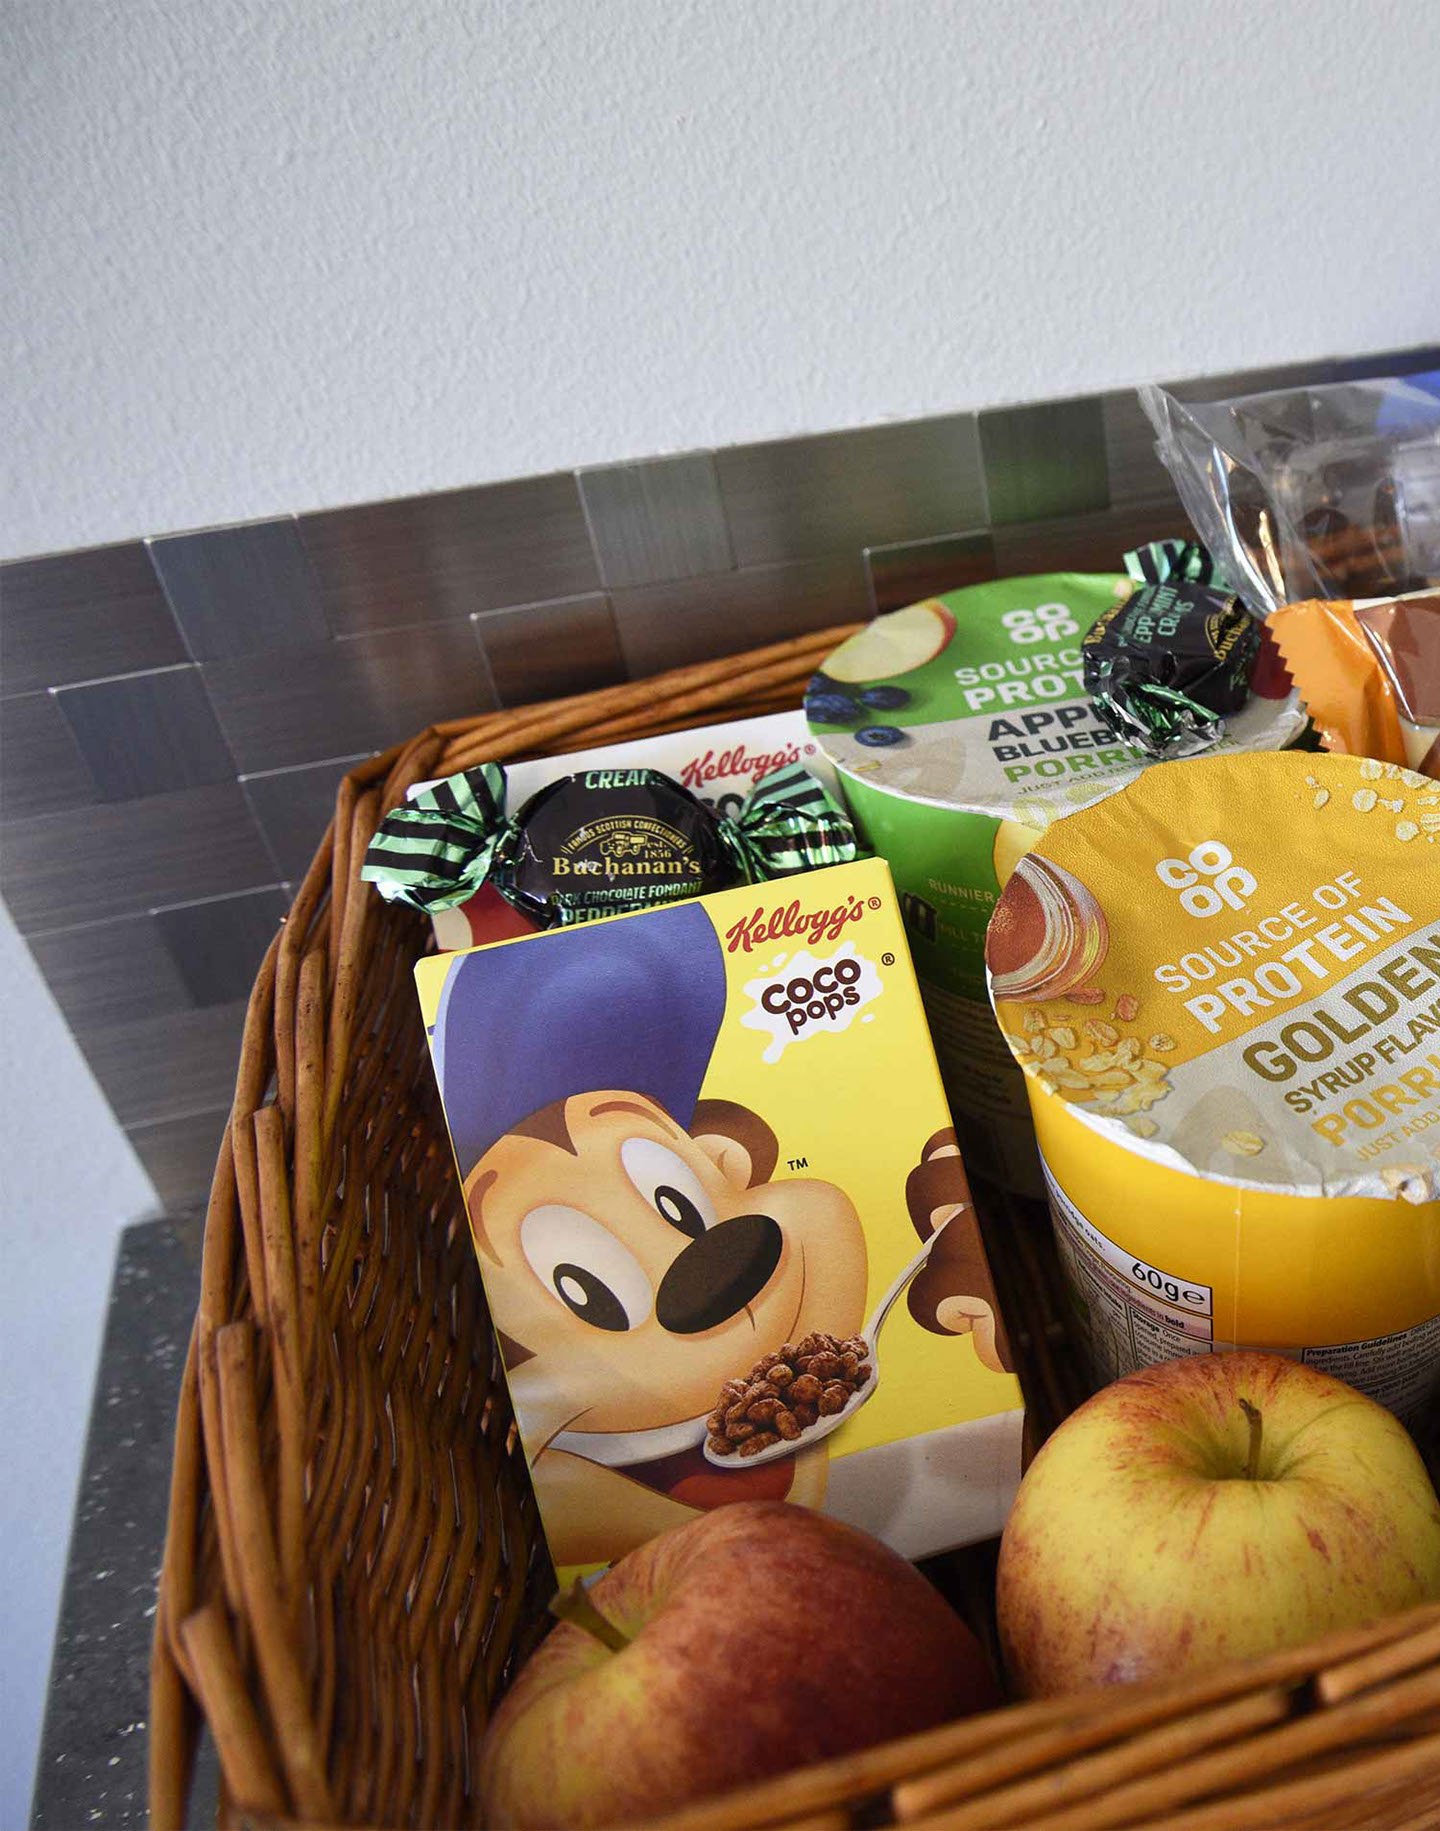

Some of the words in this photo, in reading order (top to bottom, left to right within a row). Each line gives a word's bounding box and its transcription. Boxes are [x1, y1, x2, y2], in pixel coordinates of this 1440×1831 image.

[954, 649, 1085, 687] SOURC
[962, 669, 1086, 712] PROT
[988, 702, 1106, 742] APP
[992, 728, 1119, 762] BLUEB
[680, 742, 801, 788] Kellogg's
[1003, 746, 1146, 784] PORRI
[596, 819, 633, 835] SCOTTISH
[633, 820, 687, 850] CONFECTIONERS
[552, 855, 703, 877] Buchanan's
[644, 849, 672, 859] 1856
[584, 886, 647, 904] CHOCOLATE
[648, 880, 704, 899] FONDANT
[927, 878, 994, 903] RUNNIER
[725, 895, 865, 953] Kellogg's
[1154, 901, 1318, 994] SOURCE
[1311, 869, 1368, 912] OF
[1183, 896, 1414, 1035] PROTEIN
[785, 985, 861, 1036] pops
[1284, 1049, 1379, 1114] SYRUP
[1355, 1130, 1400, 1162] JUST
[1401, 1107, 1439, 1142] ADD
[1132, 1310, 1160, 1333] Storage
[1162, 1329, 1182, 1342] Once
[1306, 1344, 1360, 1357] Preparation
[1361, 1332, 1408, 1351] Guidelines
[1160, 1337, 1192, 1355] prepared
[1353, 1347, 1385, 1361] Carefully
